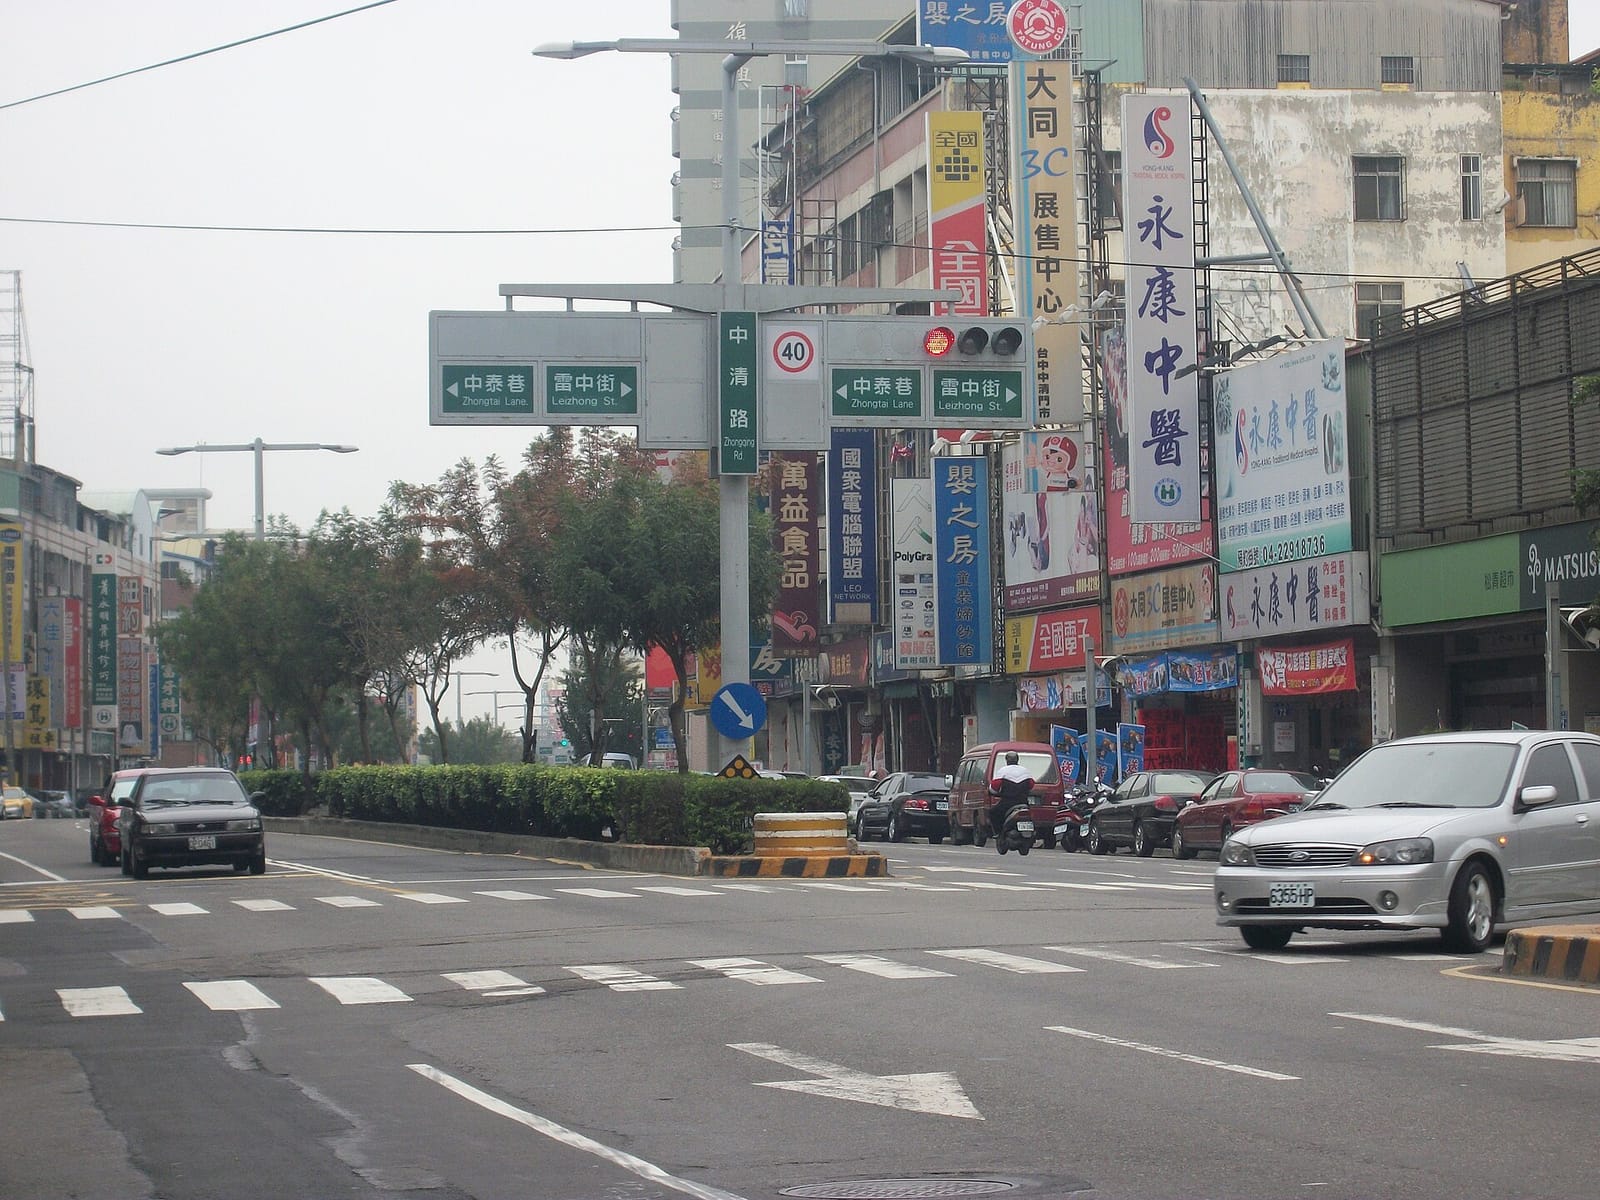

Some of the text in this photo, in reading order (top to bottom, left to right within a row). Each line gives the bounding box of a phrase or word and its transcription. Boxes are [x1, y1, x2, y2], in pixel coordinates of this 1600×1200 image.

[1015, 29, 1053, 50] TATUNG
[936, 131, 978, 147] 全國
[939, 240, 981, 316] 全國
[1137, 194, 1189, 467] 永康中醫
[781, 342, 805, 362] 40
[464, 373, 525, 393] 中泰巷
[553, 373, 615, 393] 雷中街
[729, 325, 748, 429] 中清路
[853, 376, 913, 396] 中泰巷
[940, 378, 1001, 398] 雷中街
[462, 396, 500, 407] Zhongtai
[552, 396, 598, 407] Leizhong
[851, 399, 889, 409] Zhongtai
[938, 401, 983, 411] Leizhong
[1248, 388, 1319, 455] 永康中醫
[723, 436, 755, 448] Zhongqing
[780, 460, 810, 589] 萬益食品
[945, 465, 980, 565] 嬰之房
[1262, 535, 1325, 563] 04-22918736
[1544, 550, 1600, 582] MATSUS
[843, 585, 862, 593] LEO
[1251, 565, 1321, 630] 永康中醫
[121, 578, 140, 633] 紐約
[1039, 618, 1090, 659] 全國電子
